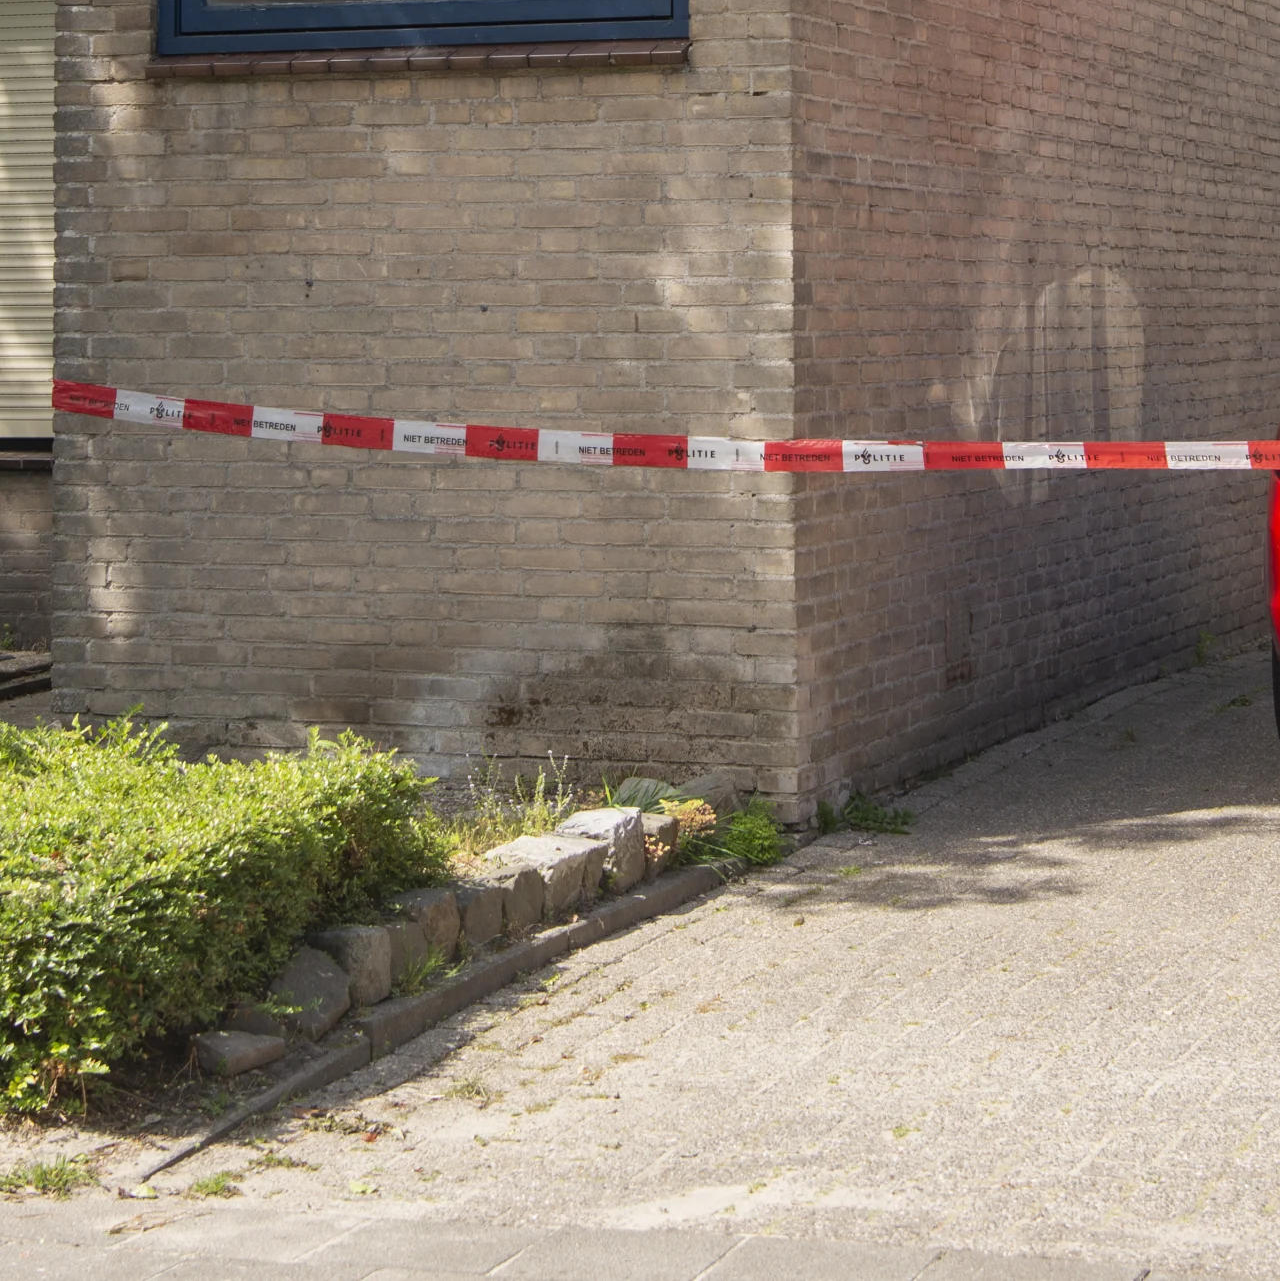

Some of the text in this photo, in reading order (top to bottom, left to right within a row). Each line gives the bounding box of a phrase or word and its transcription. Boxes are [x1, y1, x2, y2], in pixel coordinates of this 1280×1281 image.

[233, 418, 296, 432] NIET BETREDEN
[403, 434, 468, 447] NIET BETREDEN
[578, 446, 645, 457] NIET BETREDEN
[760, 453, 830, 462] NIET BETREDEN
[951, 455, 972, 463] NIET
[1147, 454, 1221, 462] NIET BETREDEN
